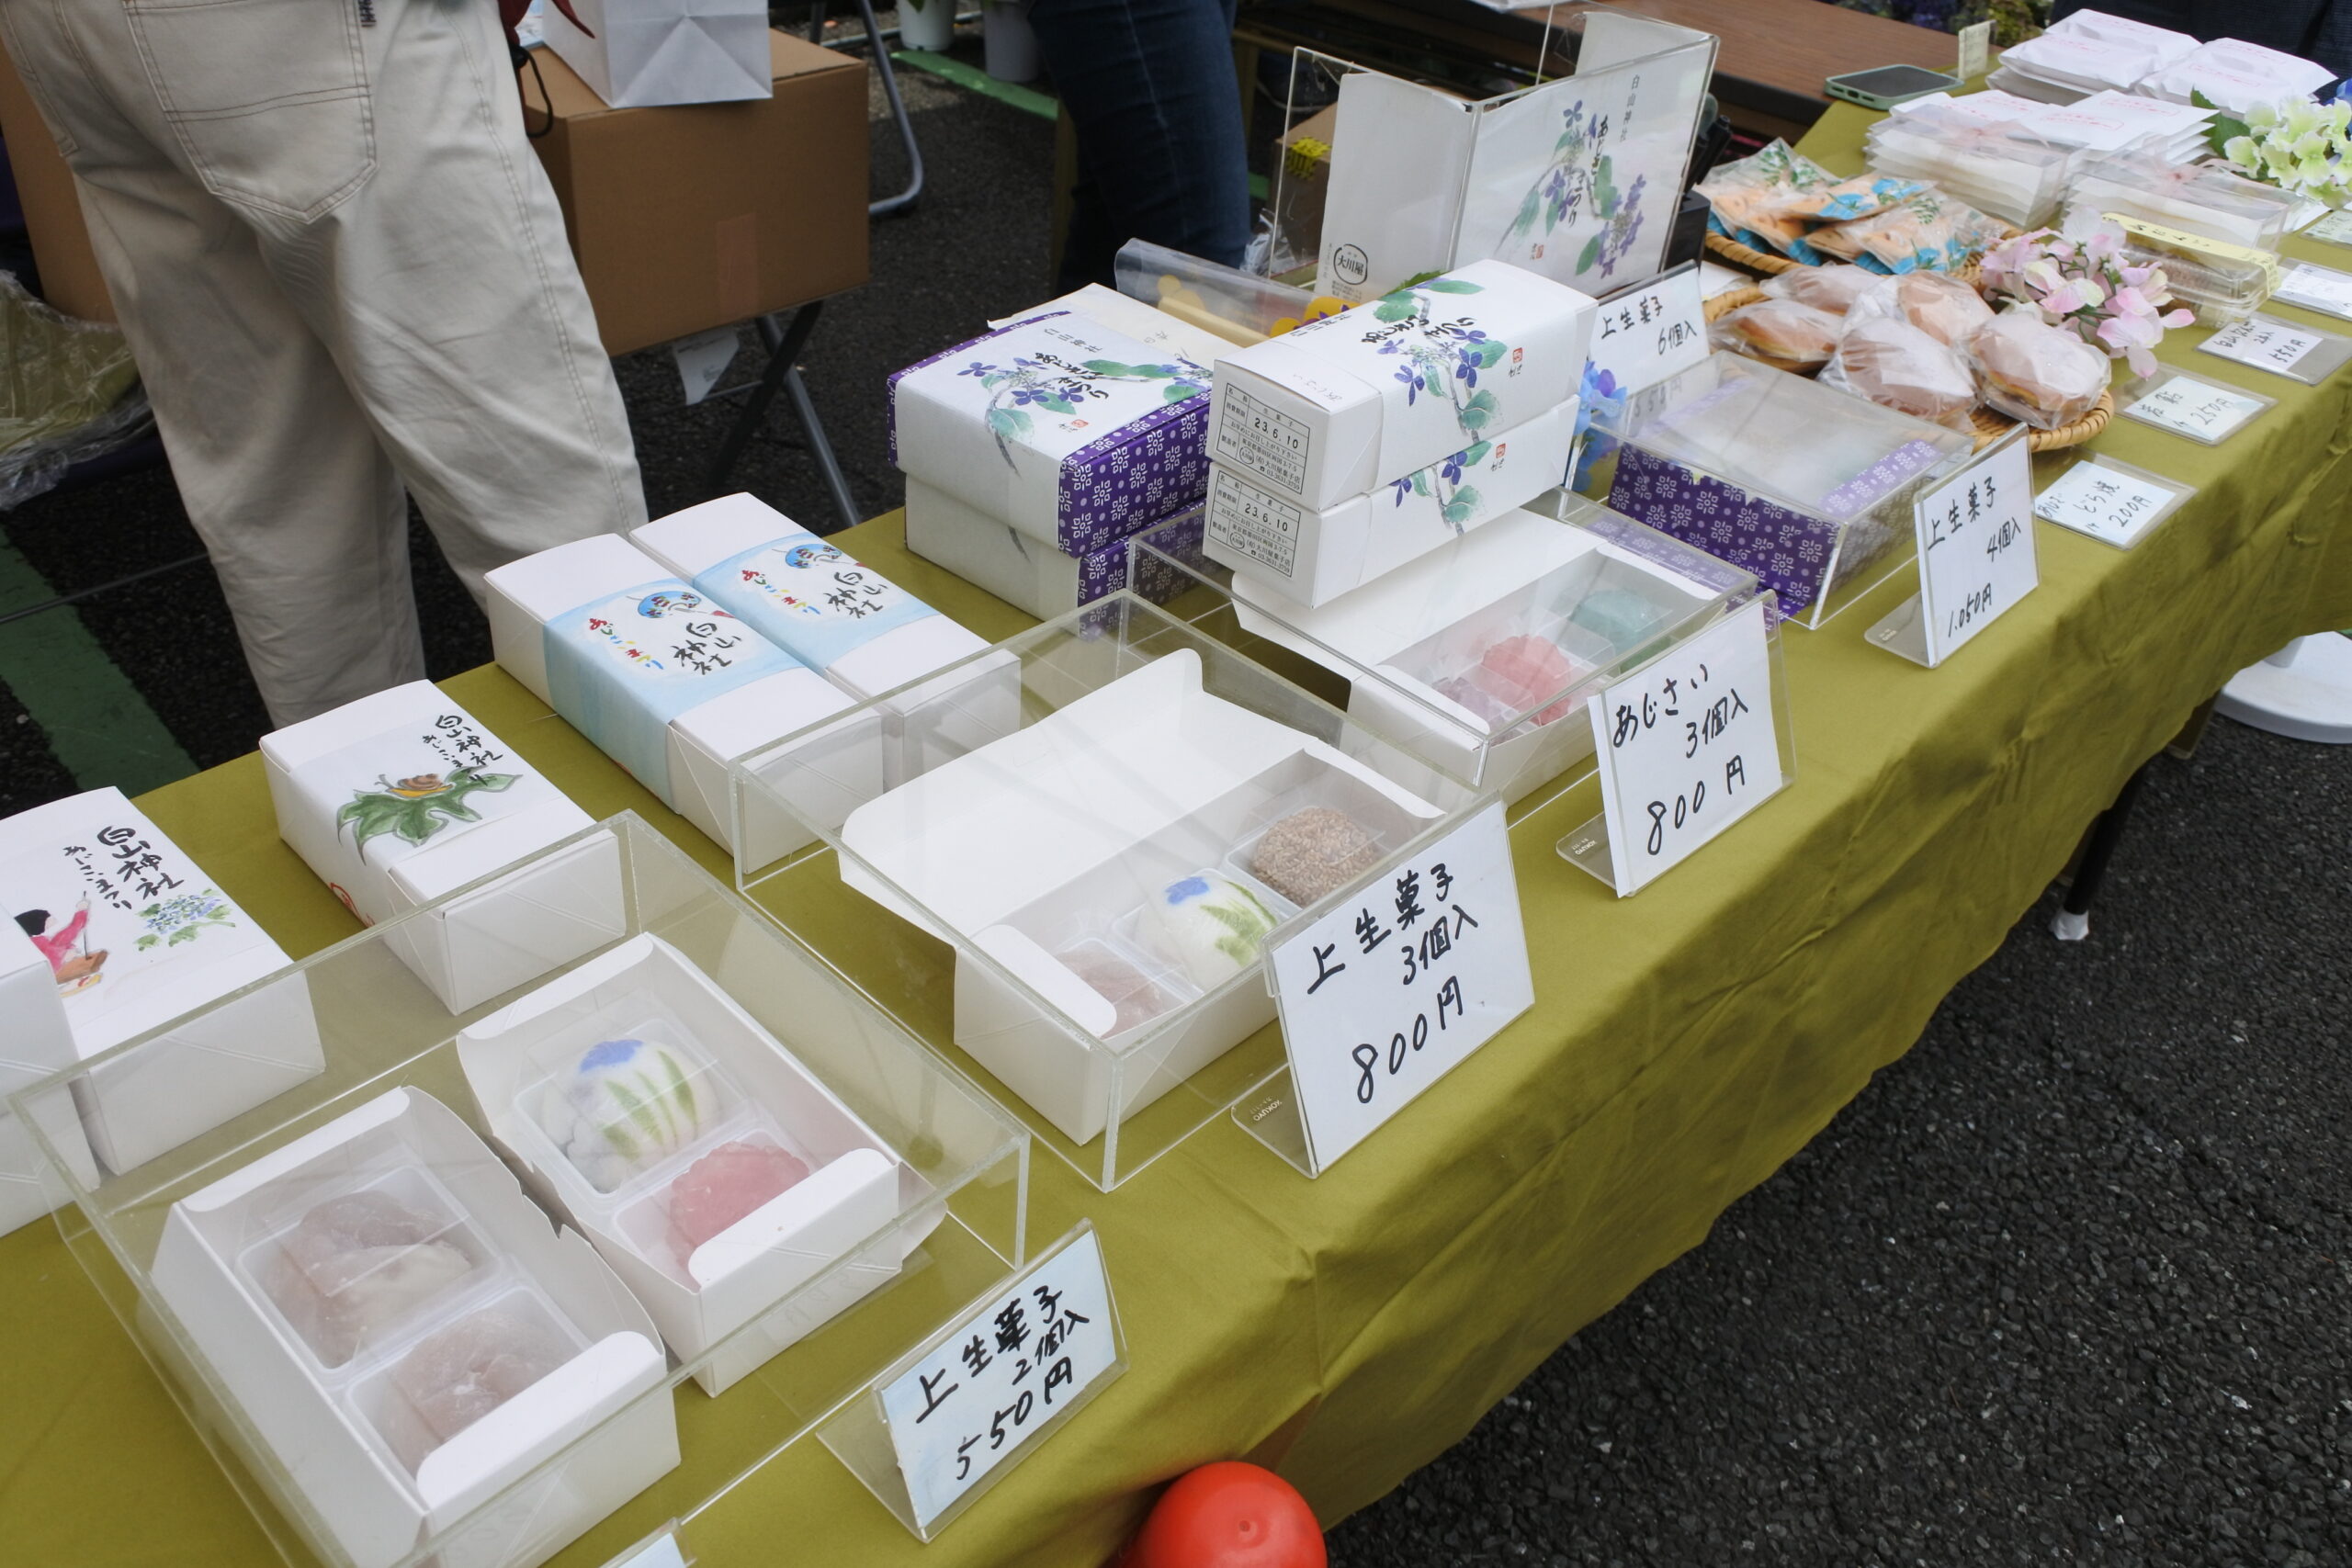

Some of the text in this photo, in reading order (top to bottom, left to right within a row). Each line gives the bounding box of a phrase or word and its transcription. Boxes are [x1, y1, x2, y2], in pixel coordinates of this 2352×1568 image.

[1620, 74, 1640, 141] 白山神社
[1337, 254, 1364, 276] 大川屋
[1601, 295, 1664, 339] 上生菓子
[1657, 320, 1697, 355] 6個入
[2267, 339, 2306, 363] 550円
[1253, 415, 1298, 450] 23.6.10
[2190, 398, 2233, 425] 250円
[1244, 502, 1288, 533] 23.6.10
[1928, 476, 1996, 551] 上生菓子
[1986, 517, 2020, 561] 4個入
[2109, 495, 2153, 528] 200円
[741, 570, 820, 615] あじさいまつり
[589, 618, 664, 670] あじさいまつり
[1612, 663, 1708, 748] あじさい
[1686, 688, 1748, 758] 3個入
[435, 715, 503, 765] 白山神社
[1647, 755, 1745, 855] 800円
[96, 825, 184, 900] 白山神社
[1307, 863, 1453, 994] 上生菓子
[1403, 905, 1478, 985] 3個入
[1352, 976, 1463, 1104] 800円
[915, 1285, 1062, 1424] 上生菓子
[1012, 1309, 1090, 1385] 2個入
[956, 1357, 1072, 1480] 550円
